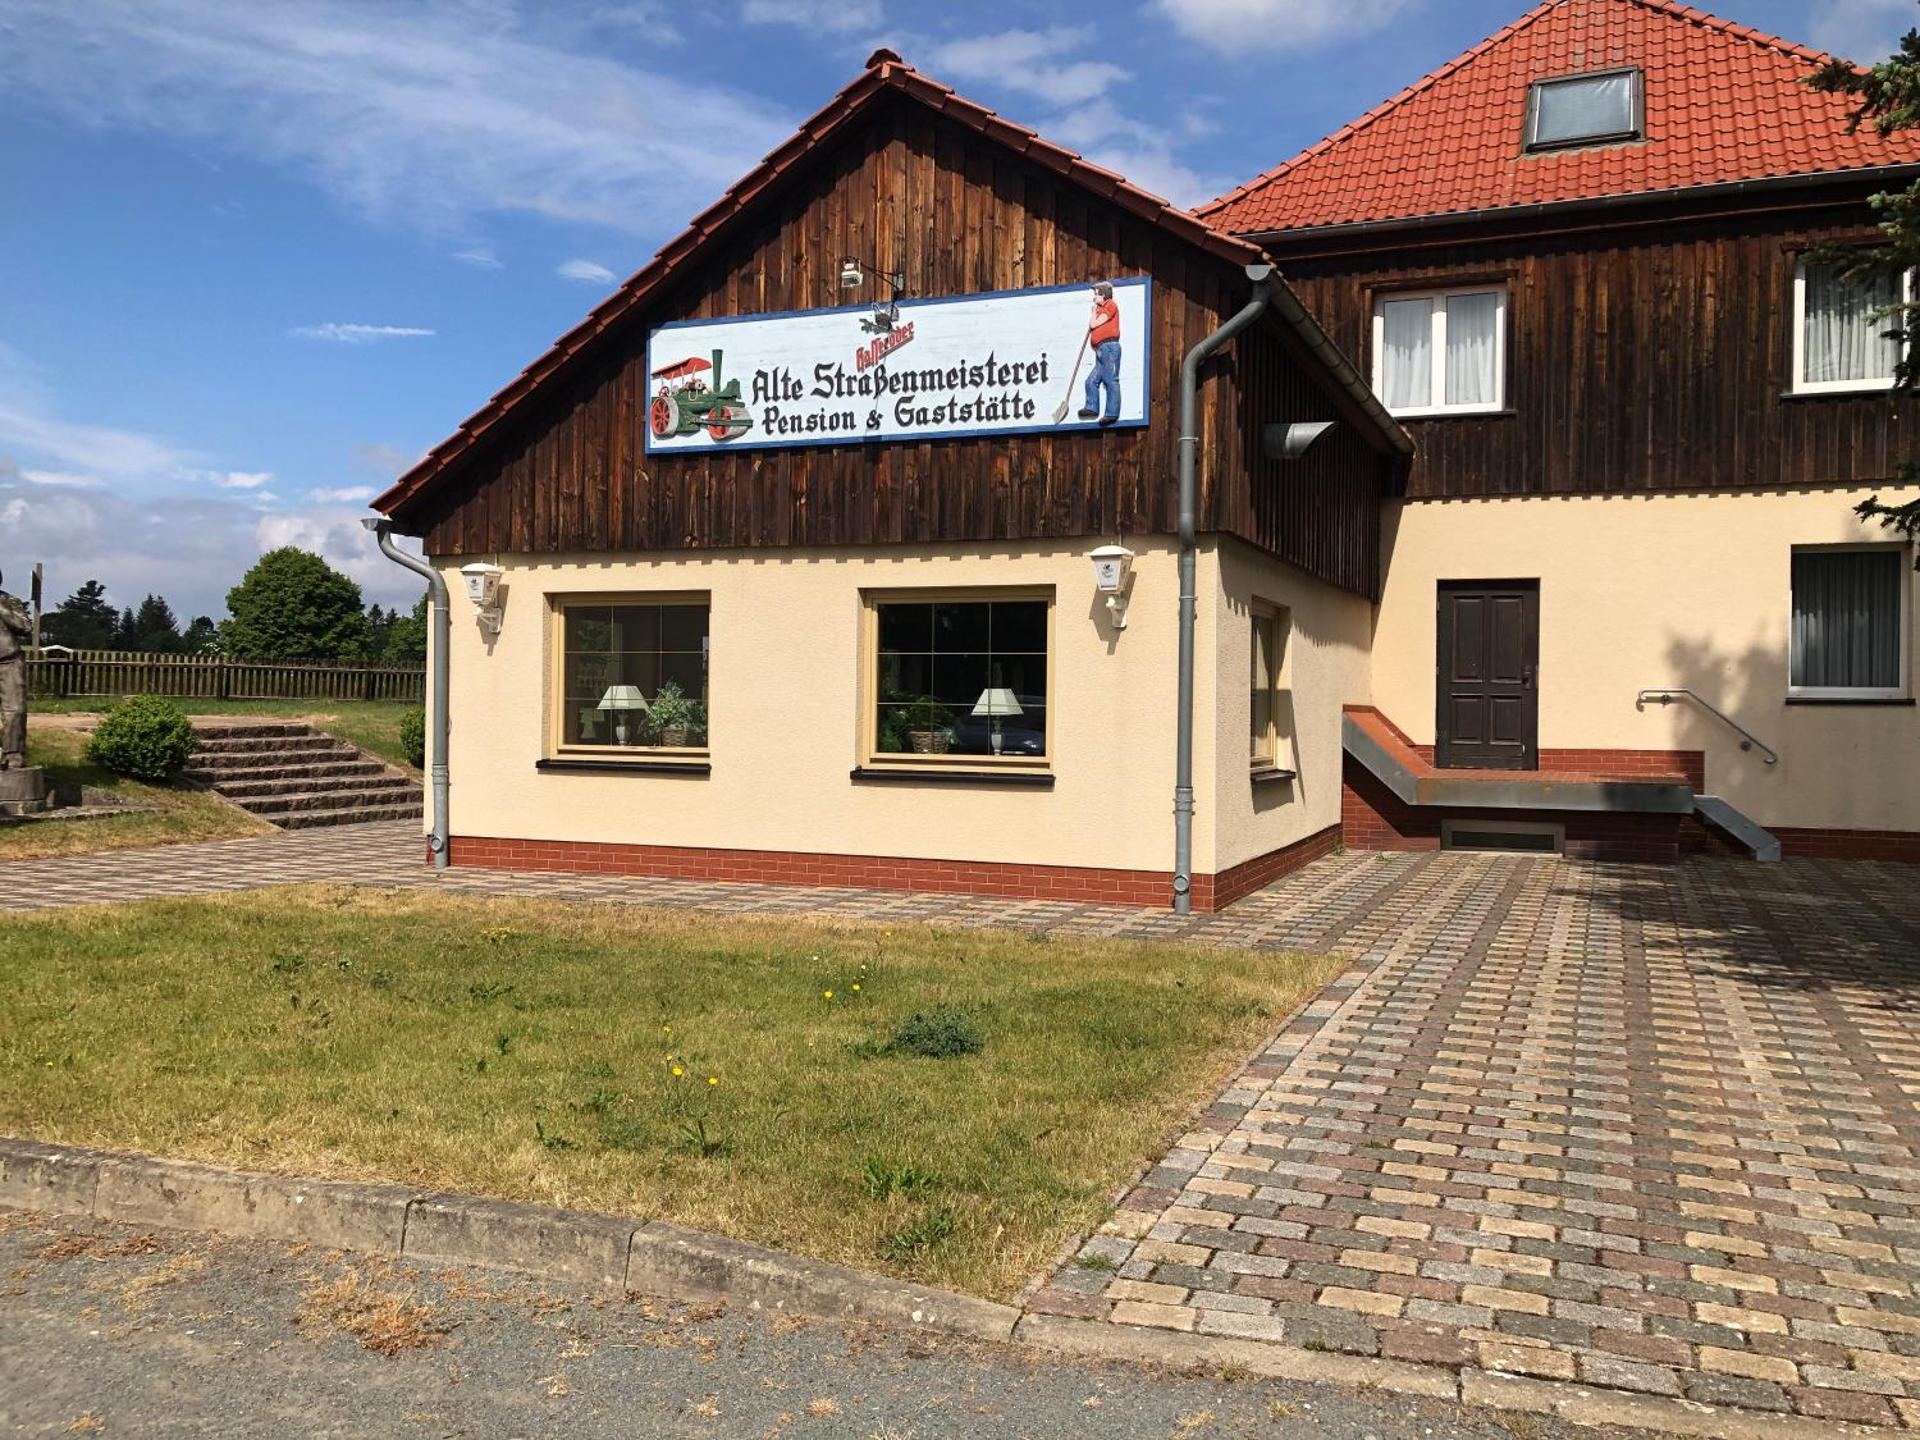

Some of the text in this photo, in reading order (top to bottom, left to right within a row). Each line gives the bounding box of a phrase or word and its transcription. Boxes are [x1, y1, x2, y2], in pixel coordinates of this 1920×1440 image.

[752, 352, 1049, 405] Alte Straßenmeisterei
[761, 390, 1035, 435] Pension & Gaststätte
